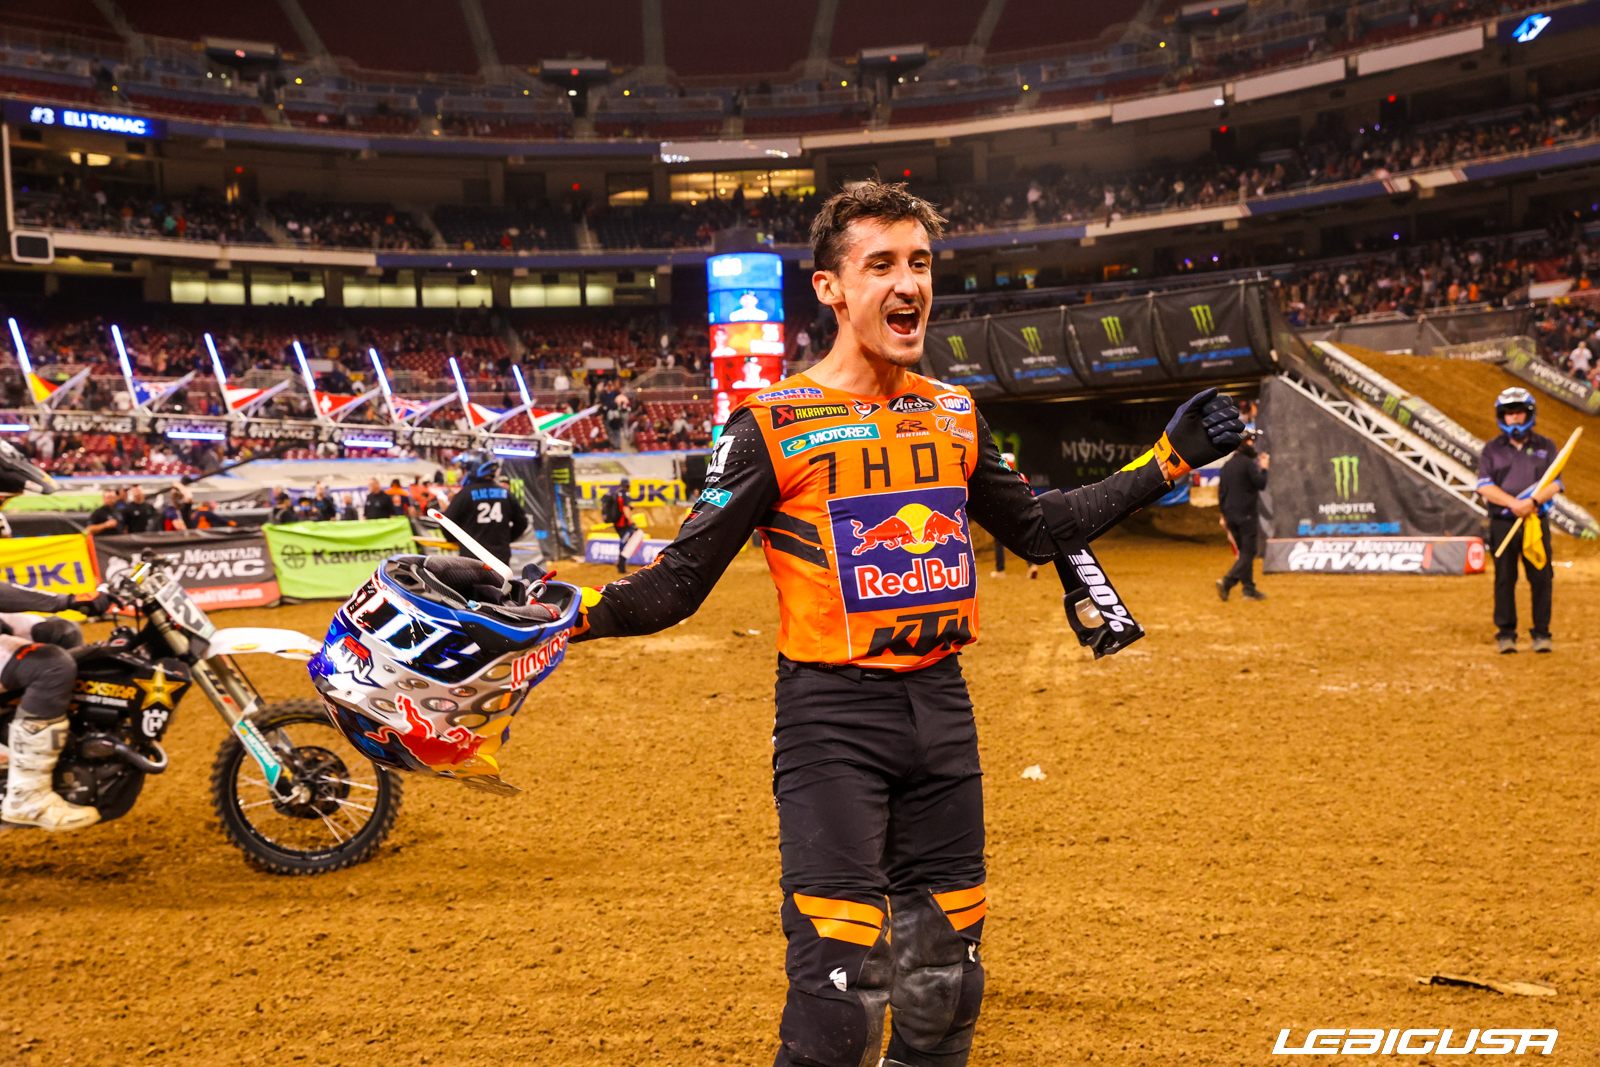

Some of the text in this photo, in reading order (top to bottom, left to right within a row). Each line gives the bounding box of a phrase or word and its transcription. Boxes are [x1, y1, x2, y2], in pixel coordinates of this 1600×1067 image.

[63, 110, 88, 128] ELI
[88, 113, 146, 135] TOMAC
[757, 387, 823, 399] PARTS
[942, 397, 971, 410] 100%
[808, 426, 874, 446] MOTOREX
[896, 431, 932, 439] RENTHAL
[476, 501, 504, 524] 24
[1318, 502, 1376, 515] MONSTER
[184, 547, 261, 565] MOUNTAIN
[1352, 540, 1425, 554] MOUNTAIN
[0, 562, 86, 588] UKI
[854, 552, 970, 600] Red Bull
[1067, 548, 1135, 633] 100%
[866, 608, 973, 657] KTM
[73, 679, 137, 700] OCKSTAR
